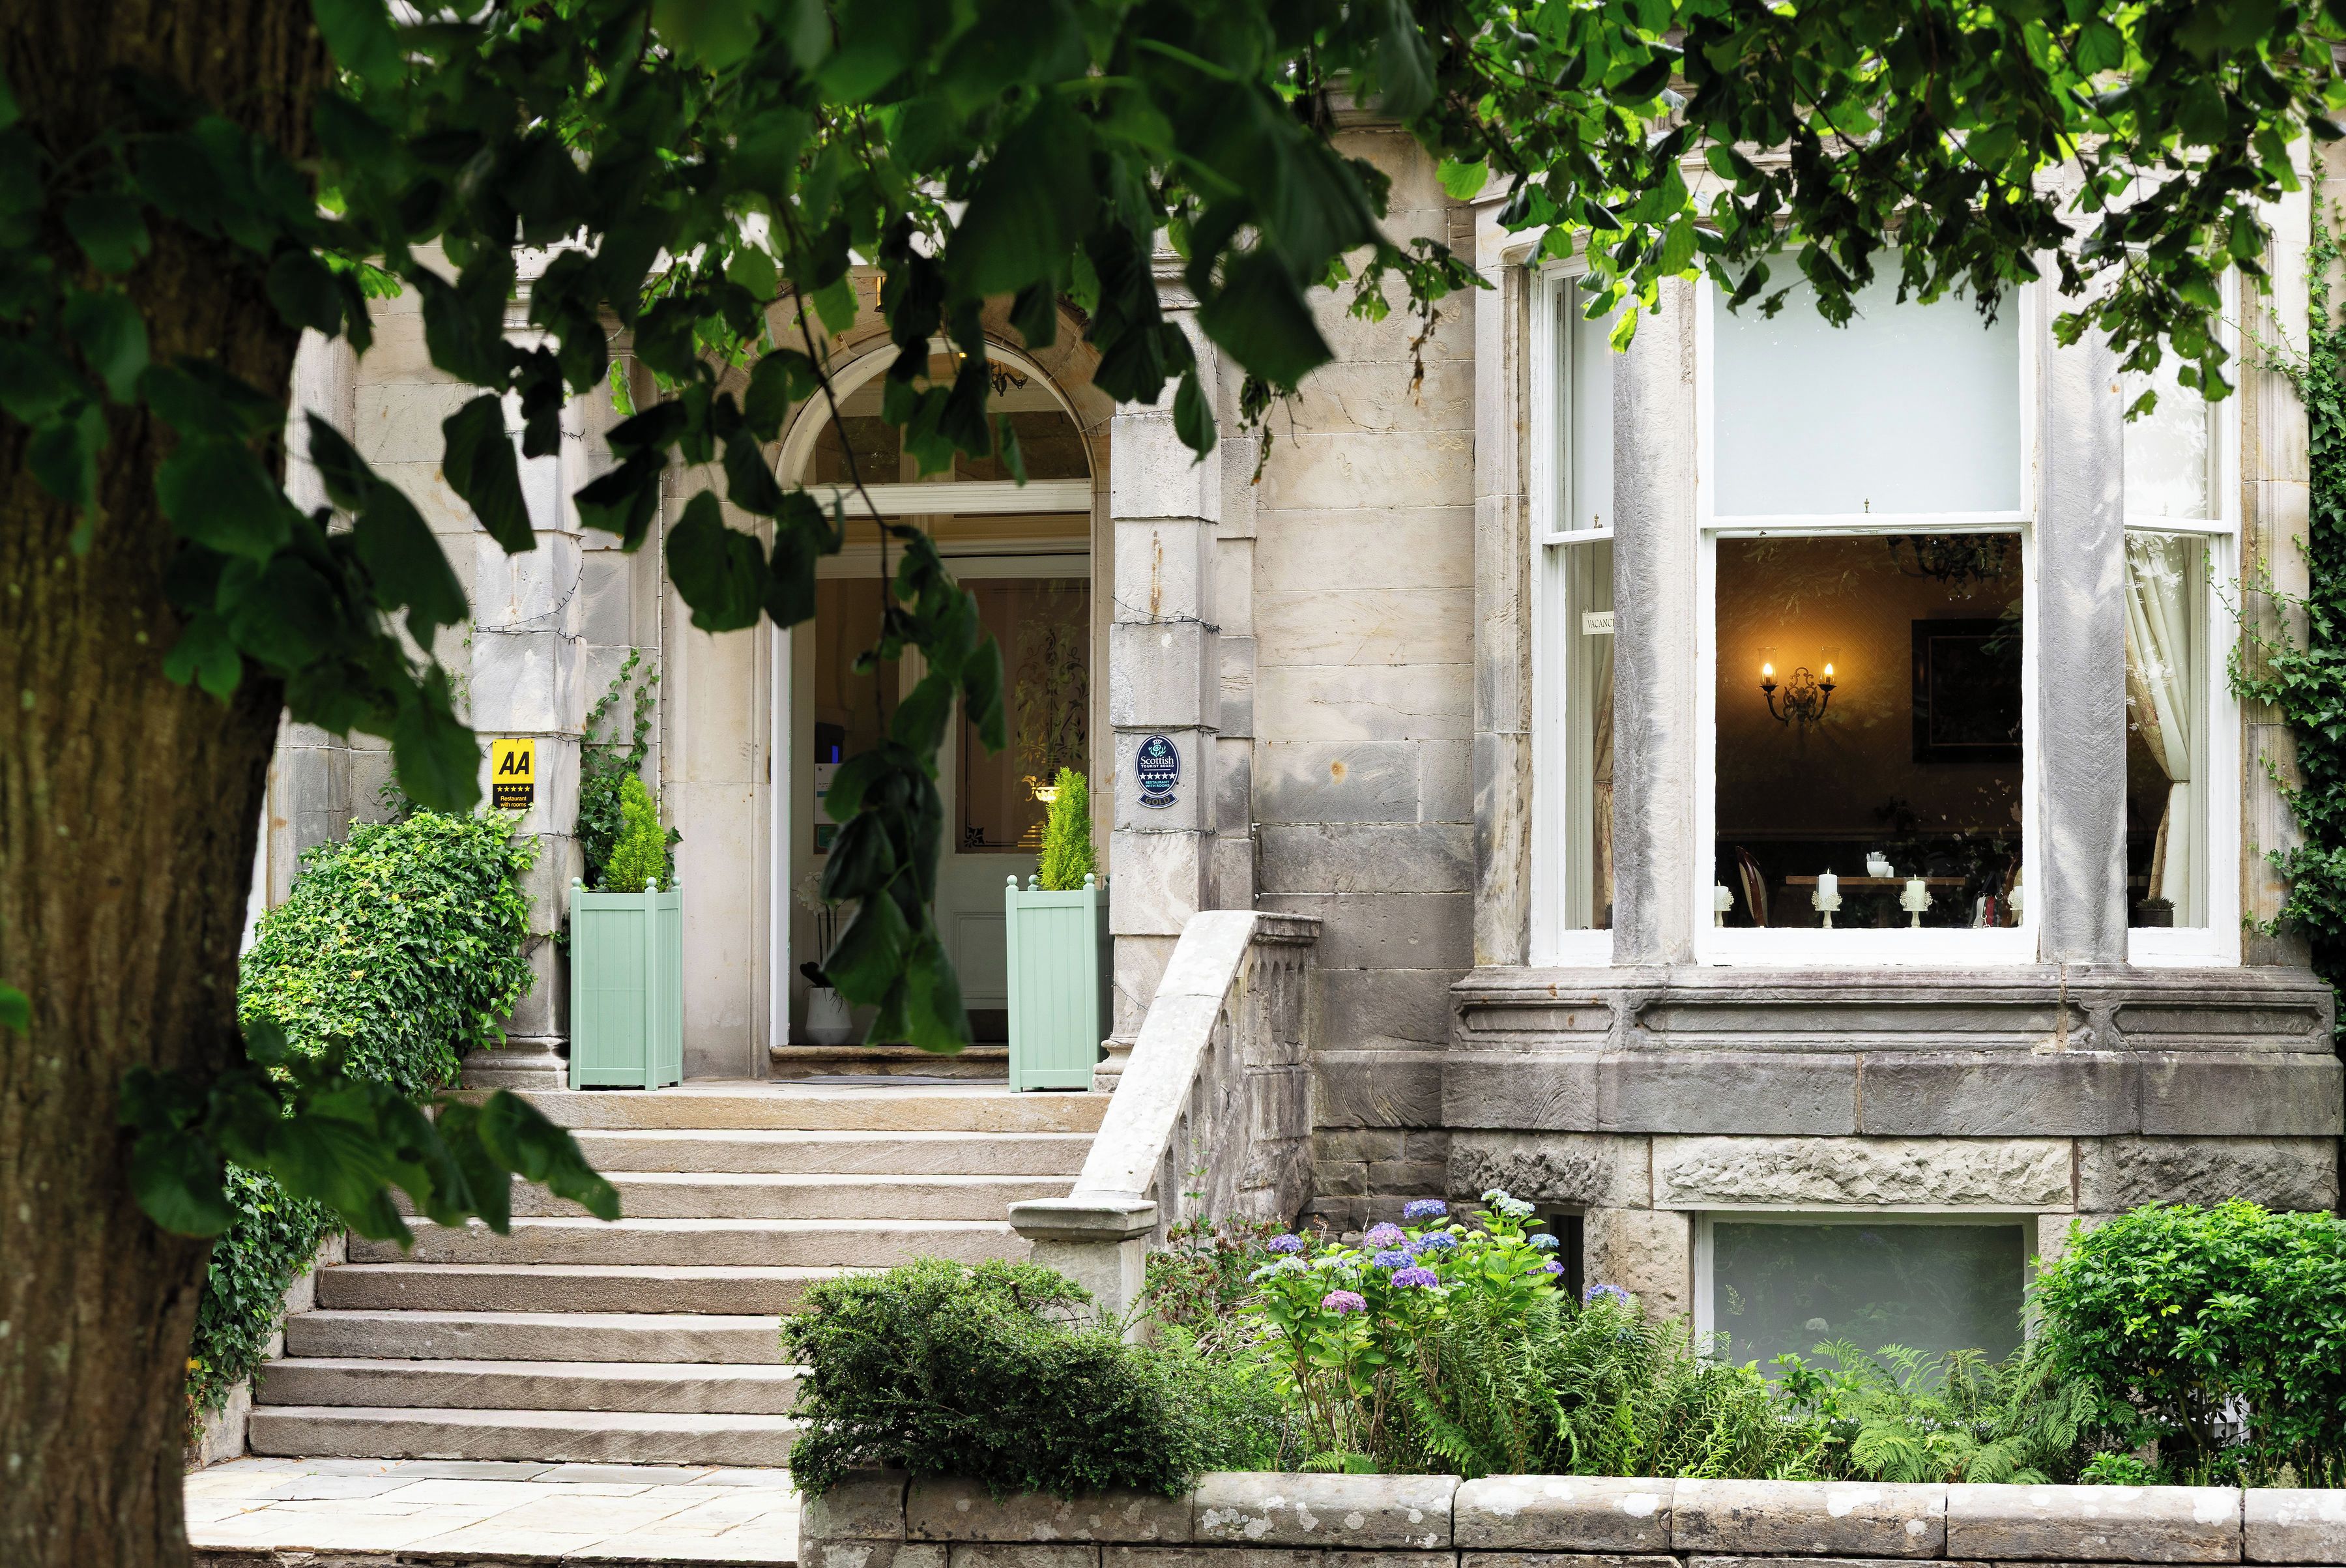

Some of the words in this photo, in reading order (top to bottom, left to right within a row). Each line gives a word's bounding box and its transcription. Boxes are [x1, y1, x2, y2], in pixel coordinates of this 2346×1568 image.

[499, 751, 529, 775] AA
[1140, 756, 1174, 764] Scottish
[1145, 797, 1170, 805] GOLD
